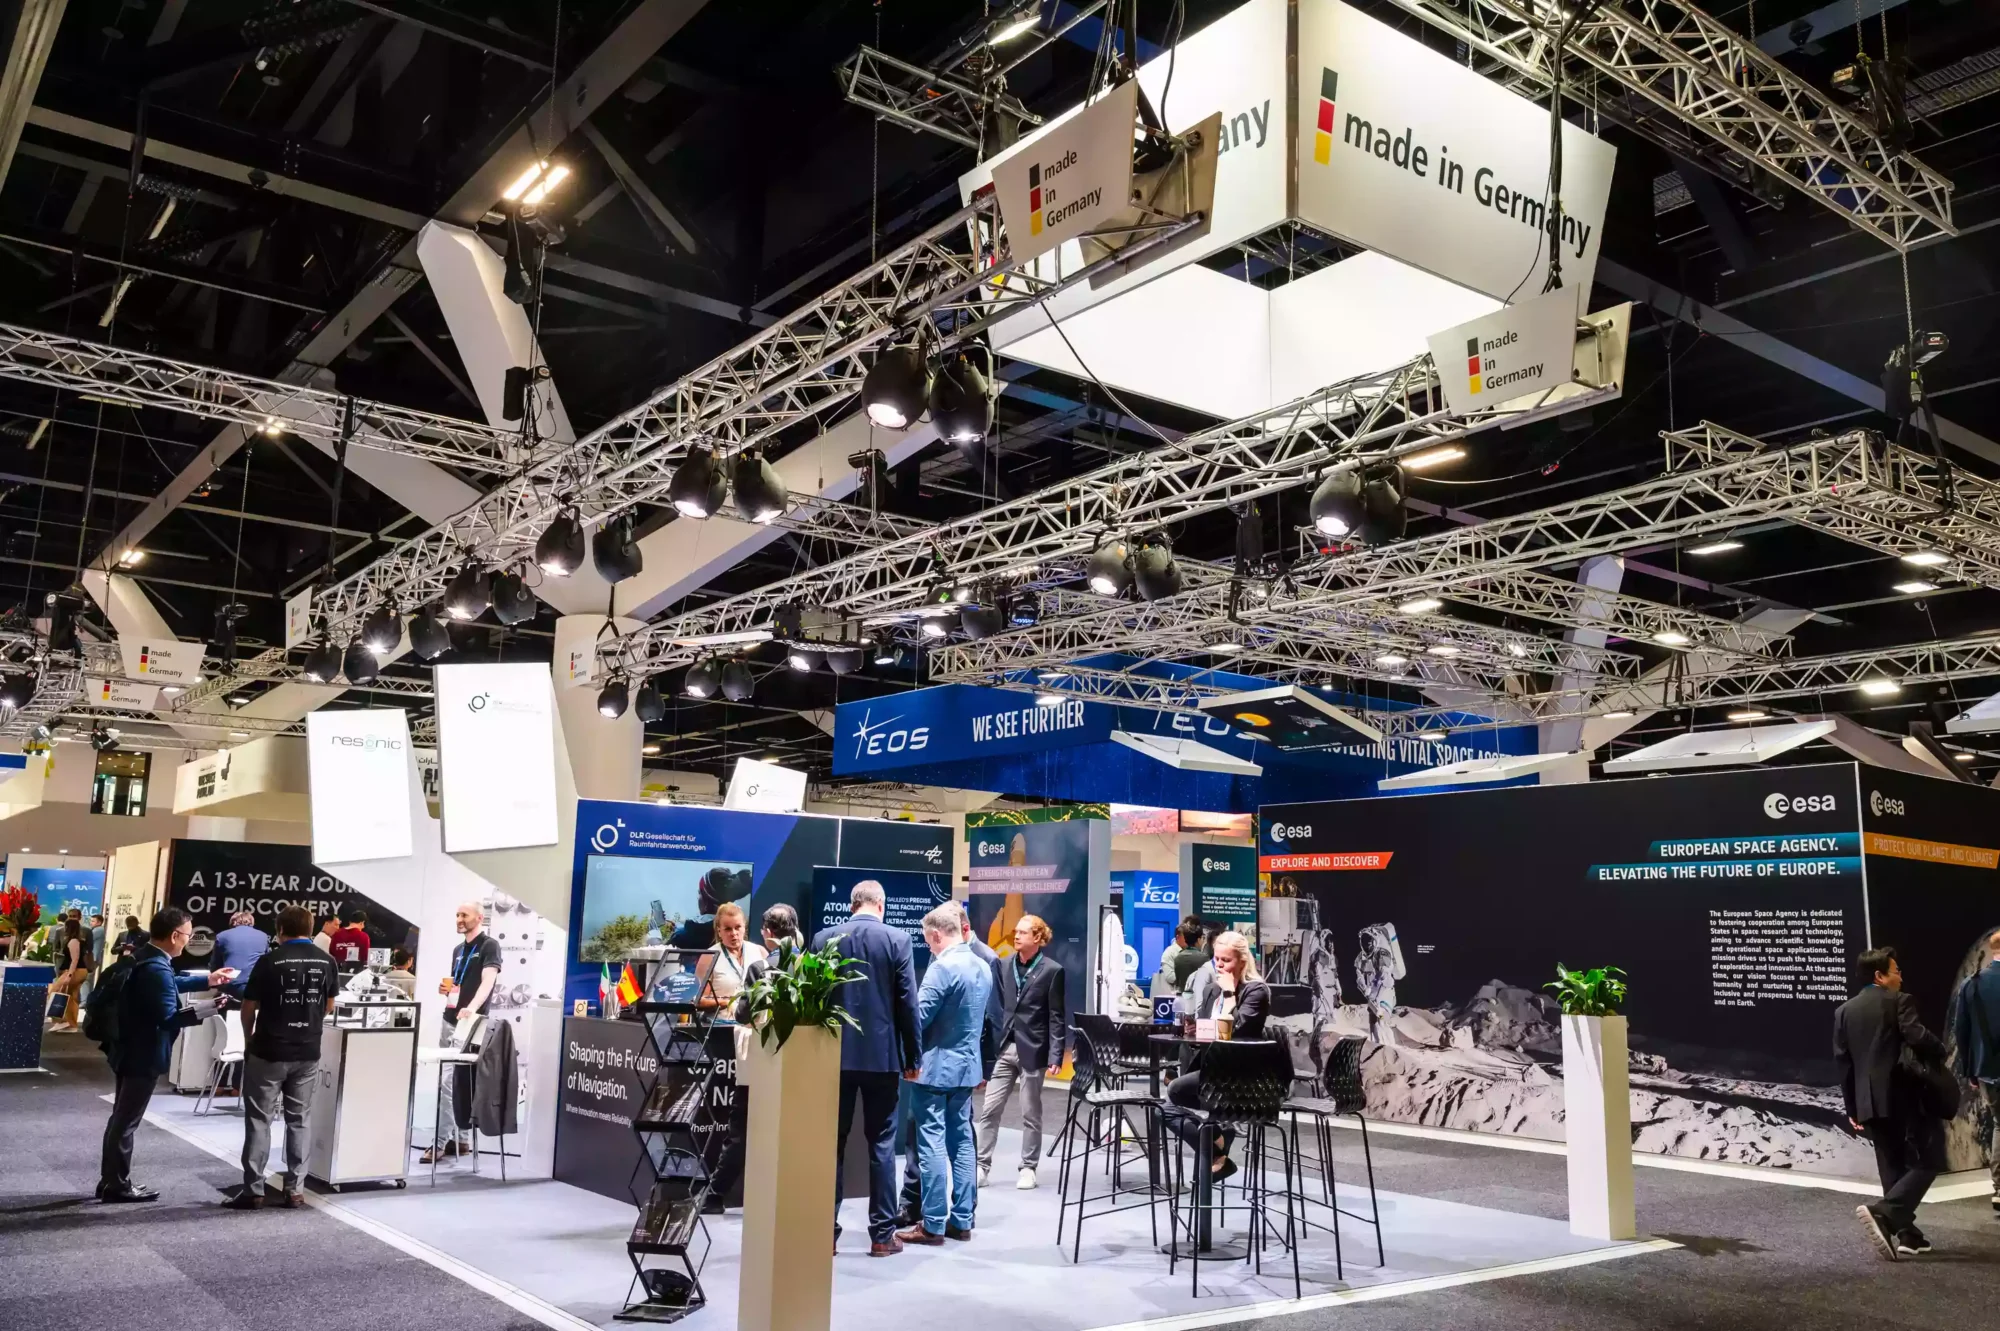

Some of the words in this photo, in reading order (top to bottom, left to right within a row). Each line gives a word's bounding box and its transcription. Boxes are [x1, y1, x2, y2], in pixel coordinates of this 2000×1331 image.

[1344, 112, 1428, 177] made
[1438, 146, 1464, 194] in
[1045, 150, 1077, 181] made
[1046, 188, 1056, 205] in
[1047, 187, 1101, 227] Germany
[1484, 331, 1518, 352] made
[1485, 358, 1495, 371] in
[1486, 363, 1543, 389] Germany
[149, 667, 182, 678] Germany
[111, 695, 141, 704] Germany
[972, 715, 993, 743] WE
[995, 708, 1019, 739] SEE
[1021, 700, 1085, 736] FURTHER
[1172, 712, 1256, 740] EO
[331, 734, 402, 751] resonic
[866, 727, 930, 755] EOS
[1399, 740, 1433, 766] VITAL
[1792, 794, 1836, 812] esa
[1884, 797, 1905, 816] esa
[645, 832, 685, 841] Gesellschaft
[687, 834, 696, 842] für
[1287, 824, 1312, 838] esa
[629, 840, 706, 852] Raumfahrtanwendungen
[1660, 842, 1730, 857] EUROPEAN
[1734, 840, 1776, 854] SPACE
[1780, 837, 1838, 852] AGENCY.
[1874, 838, 1905, 854] PROTECT
[1907, 842, 1921, 855] OUR
[1923, 844, 1948, 859] PLANET
[1951, 848, 1964, 860] AND
[1966, 850, 1993, 865] CLIMATE
[1270, 857, 1309, 868] EXPLORE
[1312, 856, 1330, 867] AND
[1333, 855, 1380, 867] DISCOVER
[1599, 866, 1667, 880] ELEVATING
[1671, 864, 1696, 878] THE
[1700, 863, 1753, 877] FUTURE
[1758, 861, 1775, 876] OF
[1779, 861, 1840, 876] EUROPE.
[977, 868, 1014, 877] STRENGTHEN
[1016, 867, 1049, 877] EUROPEAN
[188, 871, 205, 888] A
[214, 872, 300, 892] 13-YEAR
[977, 883, 1009, 891] AUTONOMY
[1011, 882, 1024, 891] AND
[1025, 882, 1062, 891] RESILIENCE
[186, 896, 217, 913] OF
[823, 902, 852, 912] ATOM
[1812, 974, 1846, 983] benefiting
[1806, 984, 1847, 992] sustainable,
[569, 1041, 604, 1068] Shaping
[607, 1049, 622, 1068] the
[567, 1072, 577, 1089] of
[578, 1076, 628, 1100] Navigation.
[566, 1103, 578, 1114] Where
[578, 1106, 598, 1118] Innovation
[599, 1112, 611, 1121] meets
